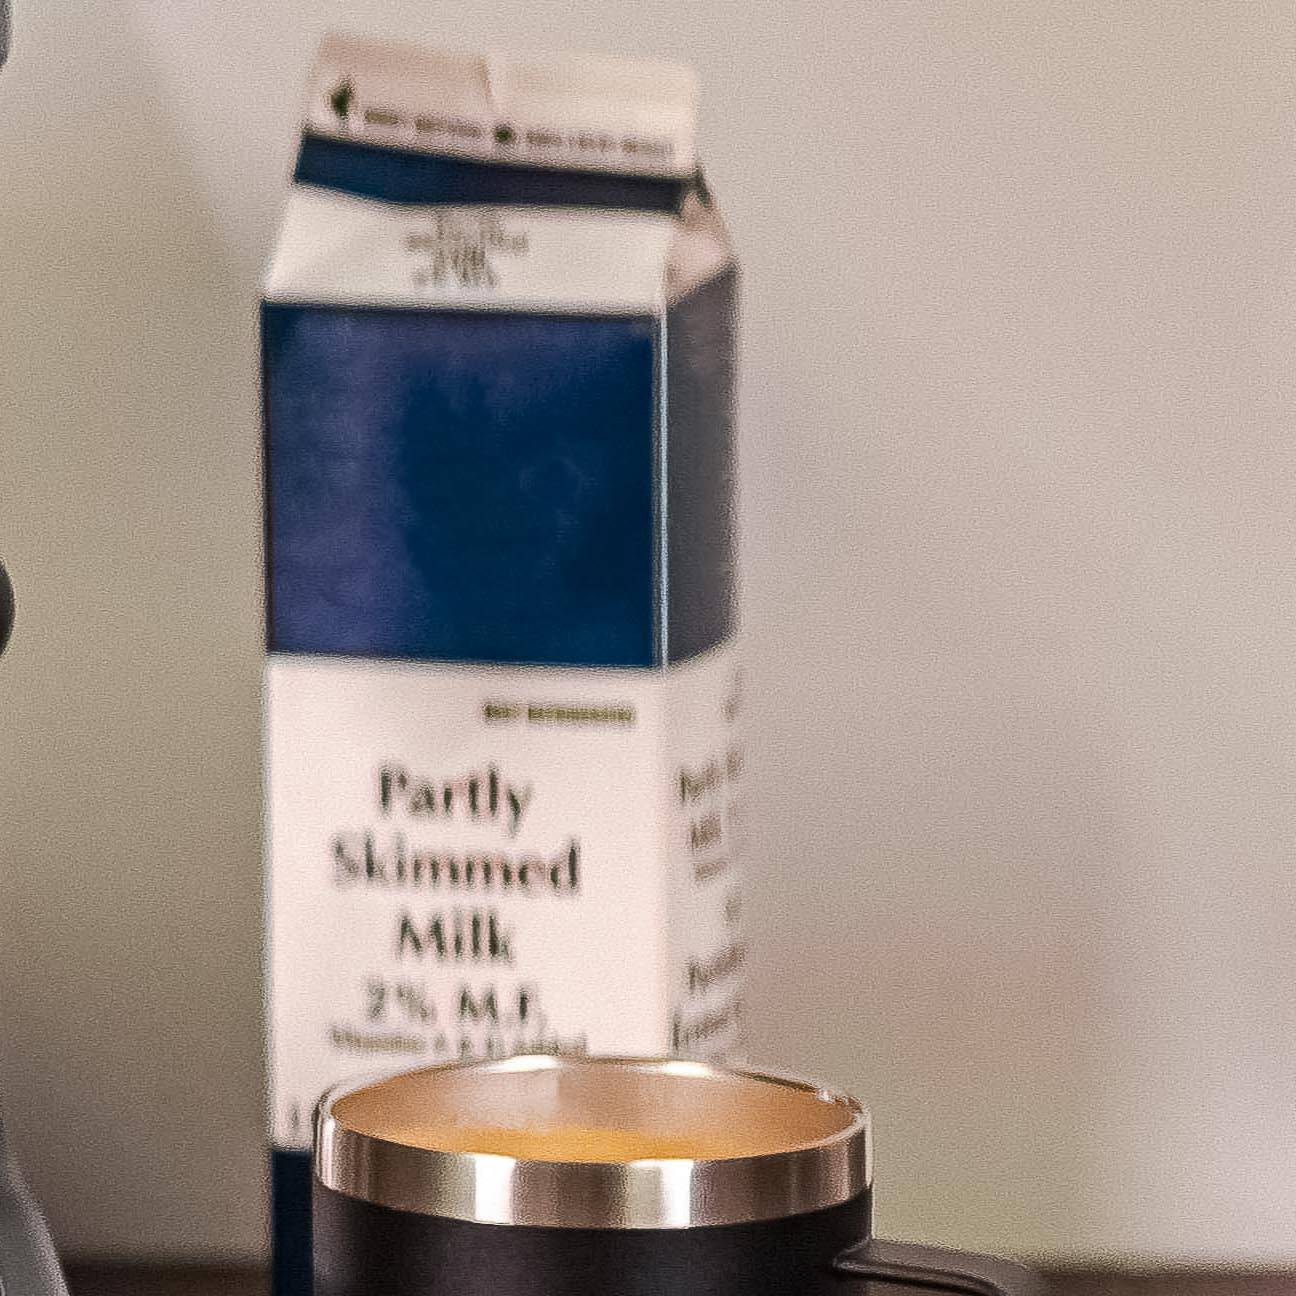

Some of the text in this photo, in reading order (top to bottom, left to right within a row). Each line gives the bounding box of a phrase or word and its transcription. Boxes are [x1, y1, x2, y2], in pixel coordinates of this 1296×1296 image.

[375, 761, 534, 836] Partly
[329, 829, 583, 894] Skimmed
[395, 906, 516, 966] Milk
